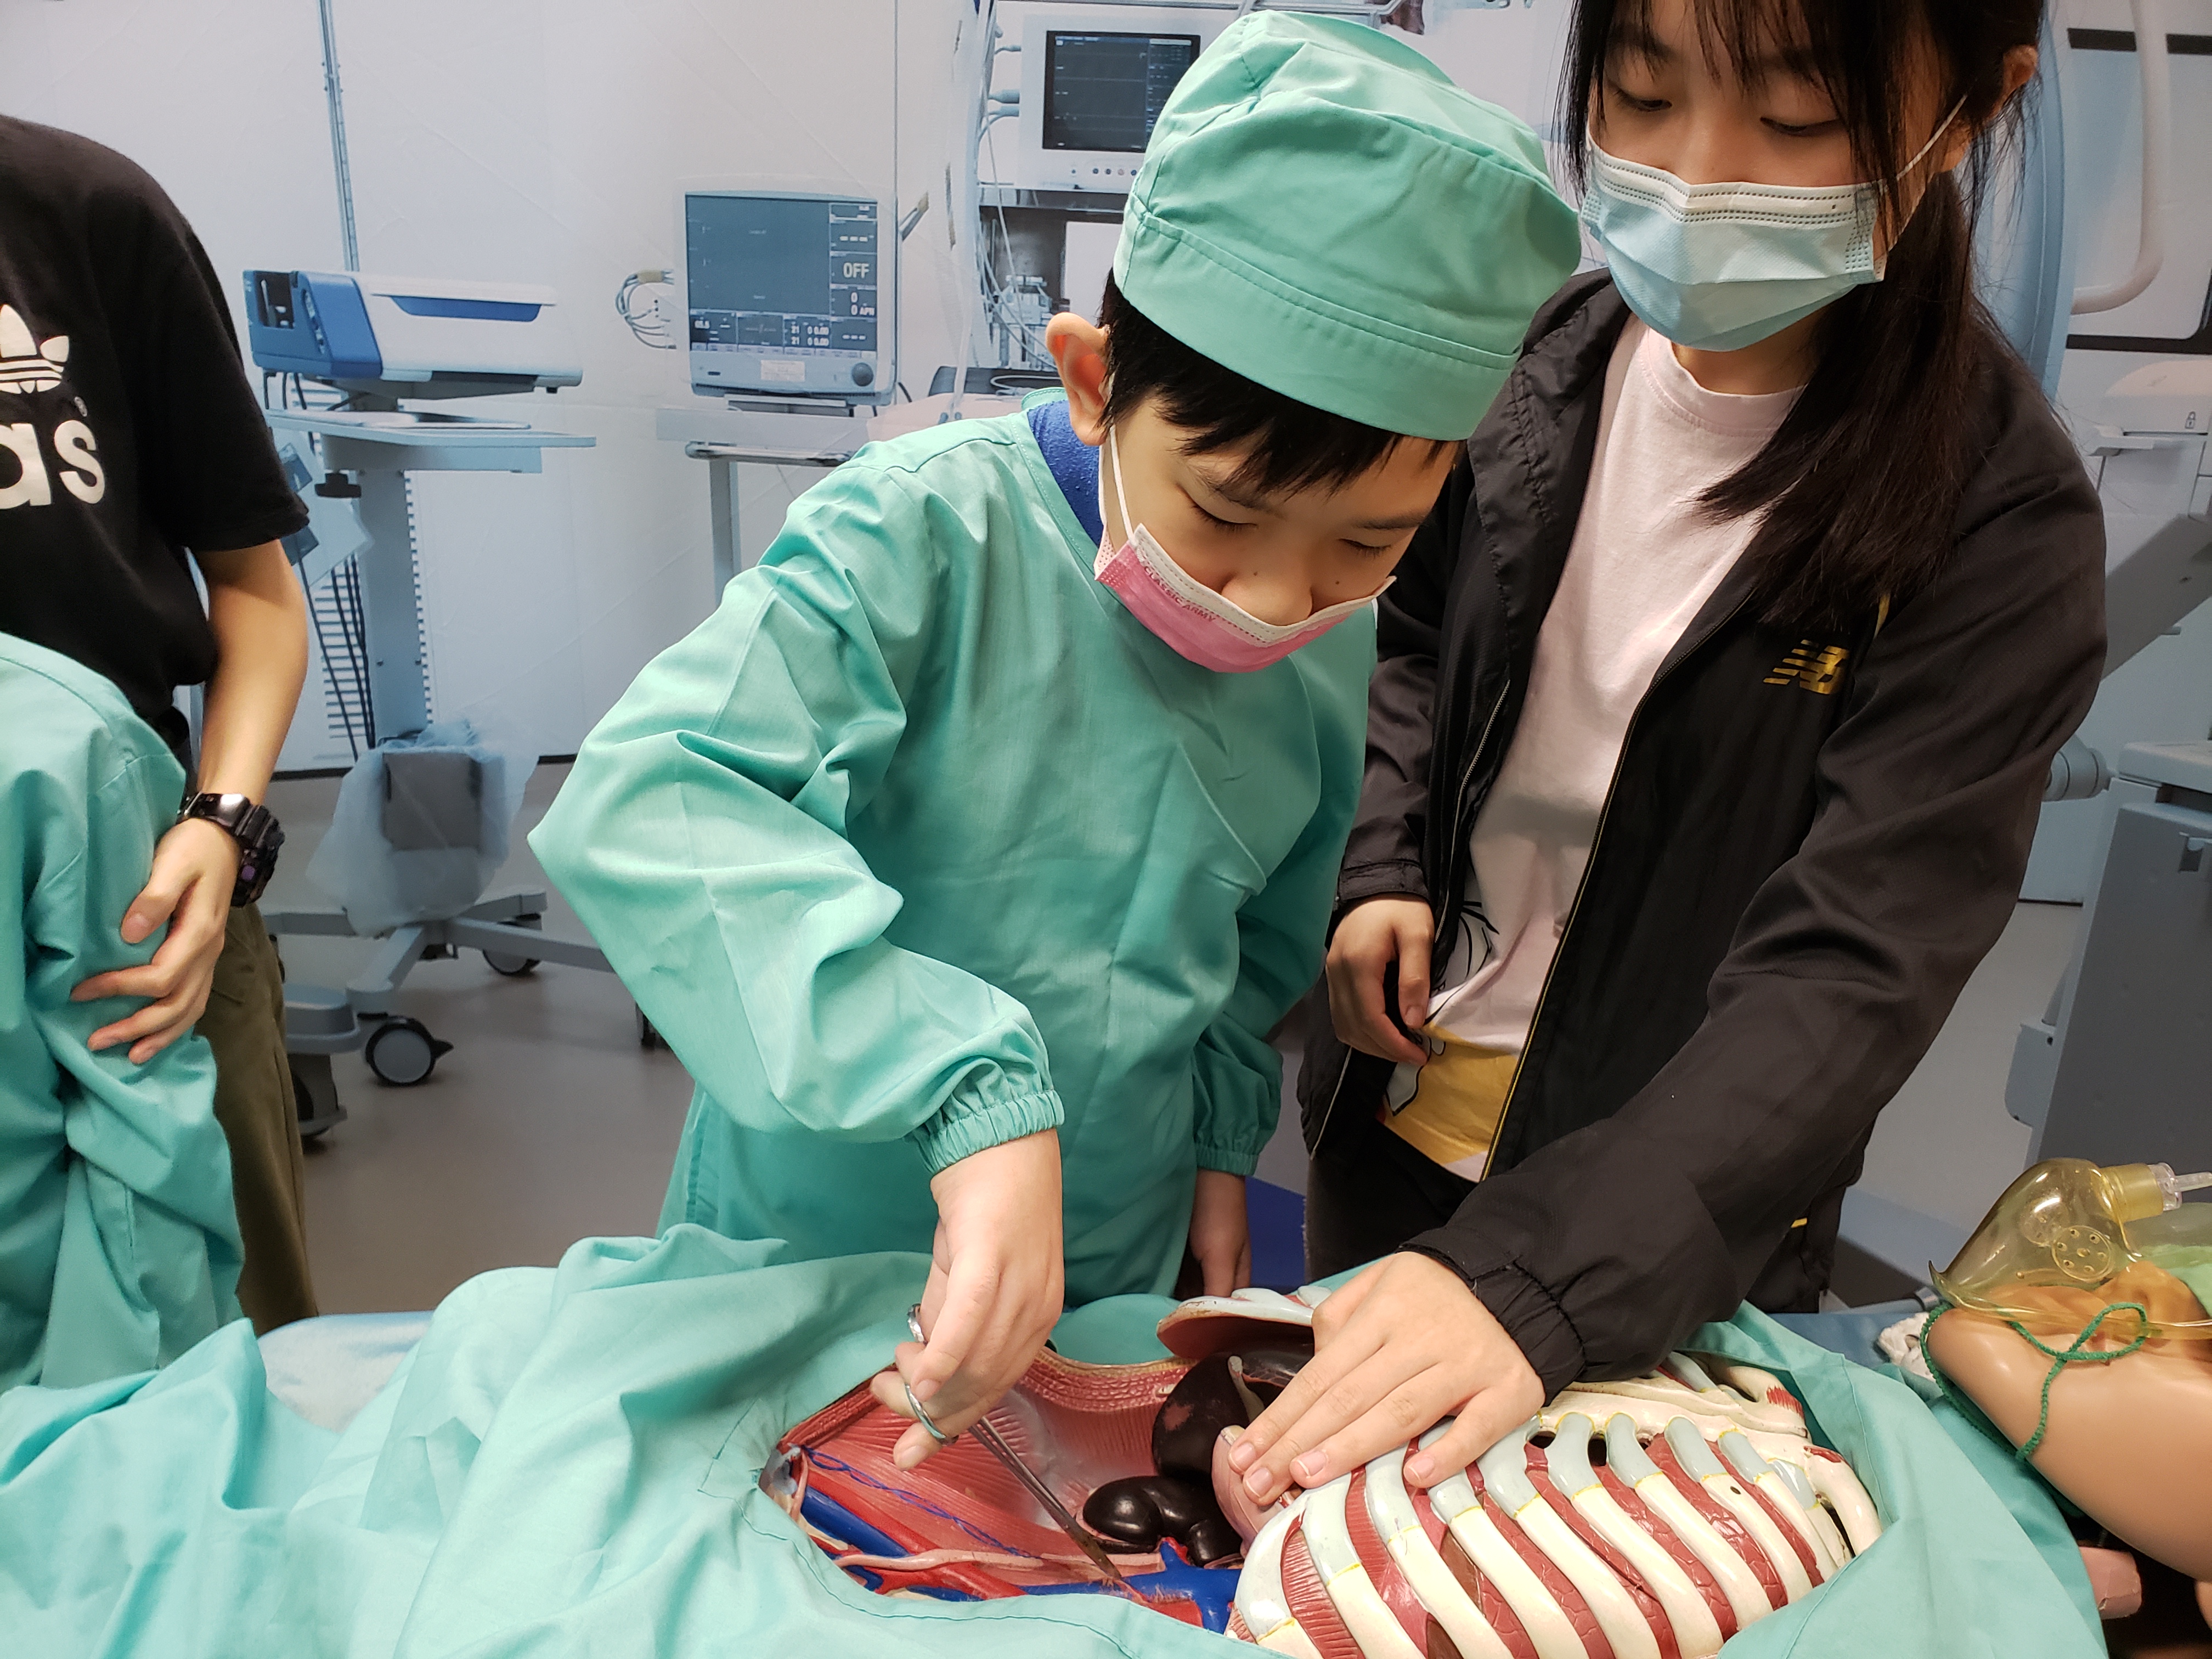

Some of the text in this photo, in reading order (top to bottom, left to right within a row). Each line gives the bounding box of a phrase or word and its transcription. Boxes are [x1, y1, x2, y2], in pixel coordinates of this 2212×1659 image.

[843, 262, 870, 278] OFF
[1144, 566, 1216, 622] CLASSIC ARMY
